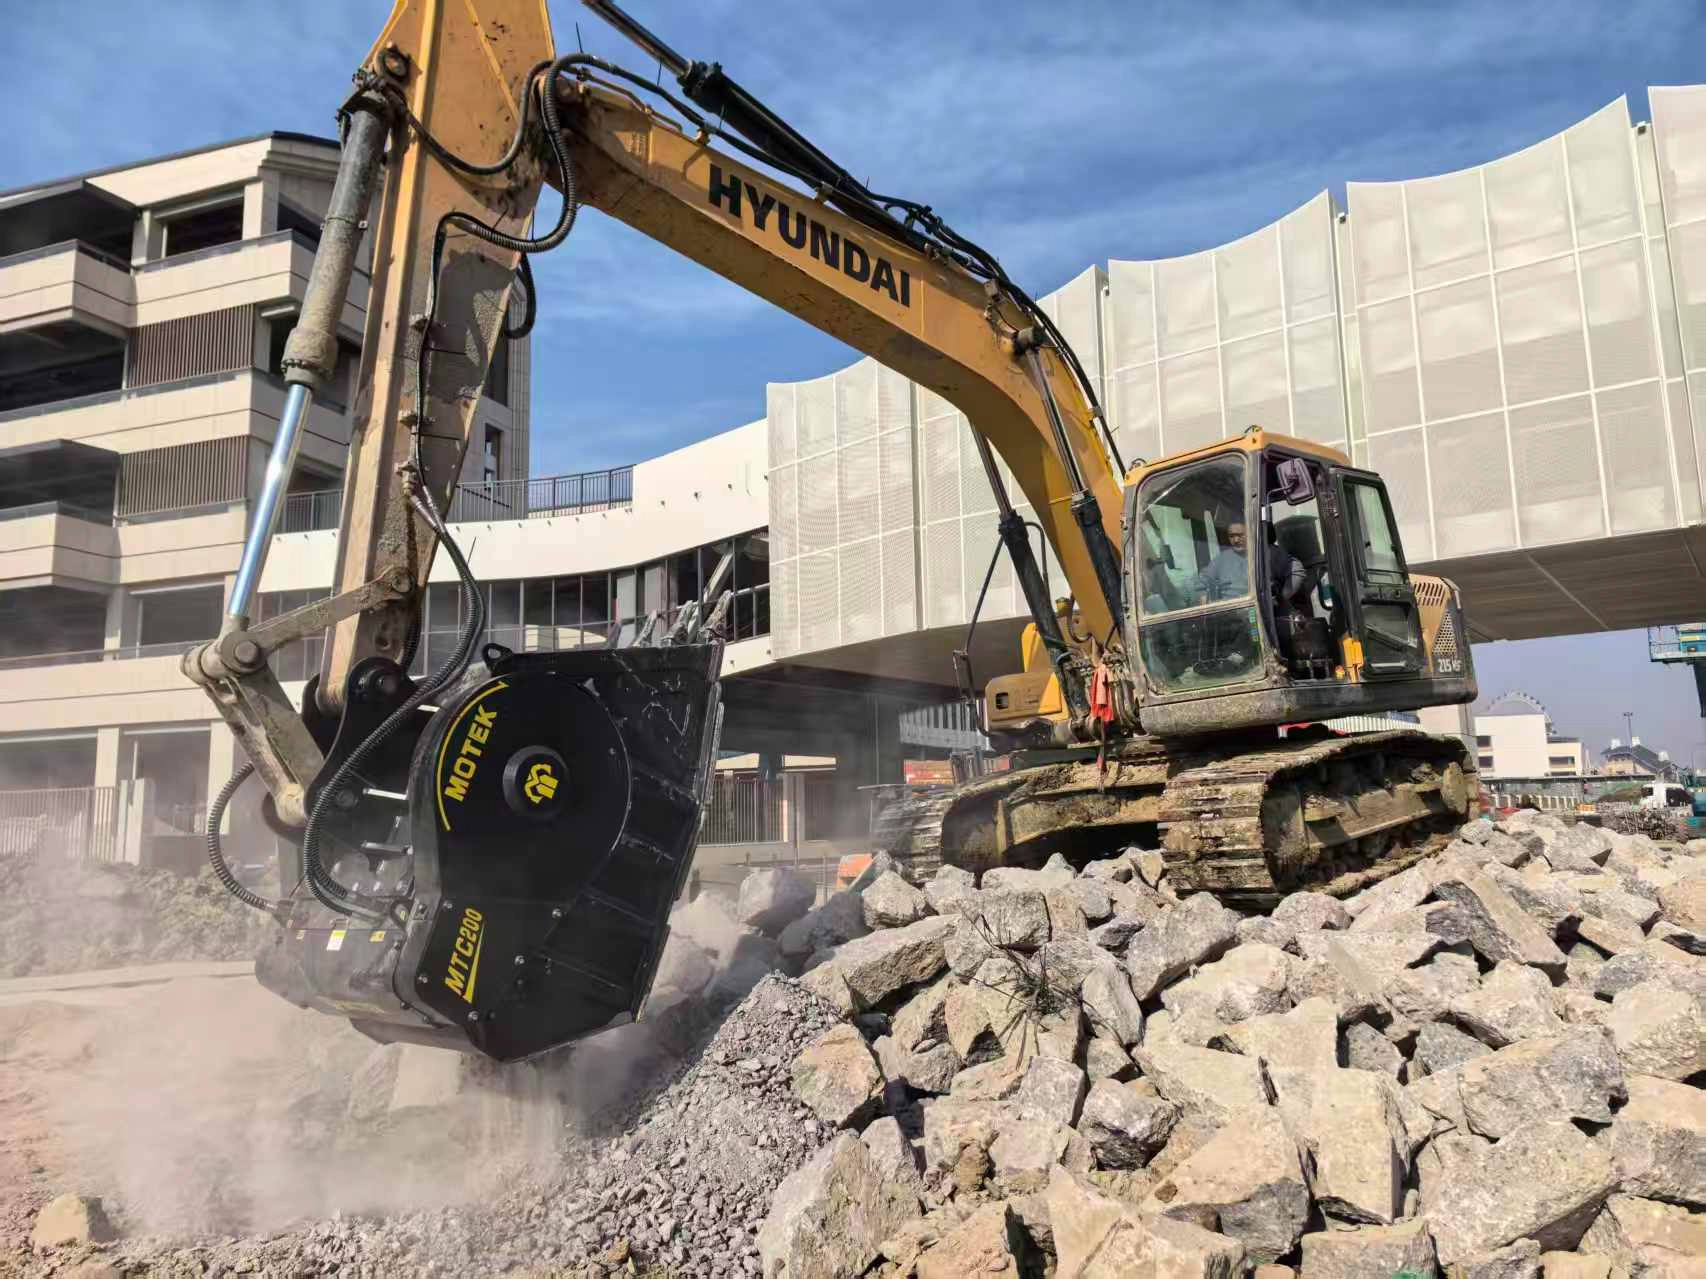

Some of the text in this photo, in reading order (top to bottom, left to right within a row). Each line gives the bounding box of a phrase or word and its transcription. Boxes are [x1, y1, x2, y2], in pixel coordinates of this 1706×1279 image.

[709, 164, 911, 308] HYUNDAI
[444, 704, 498, 802] MOTEK
[444, 907, 483, 998] MTC200
